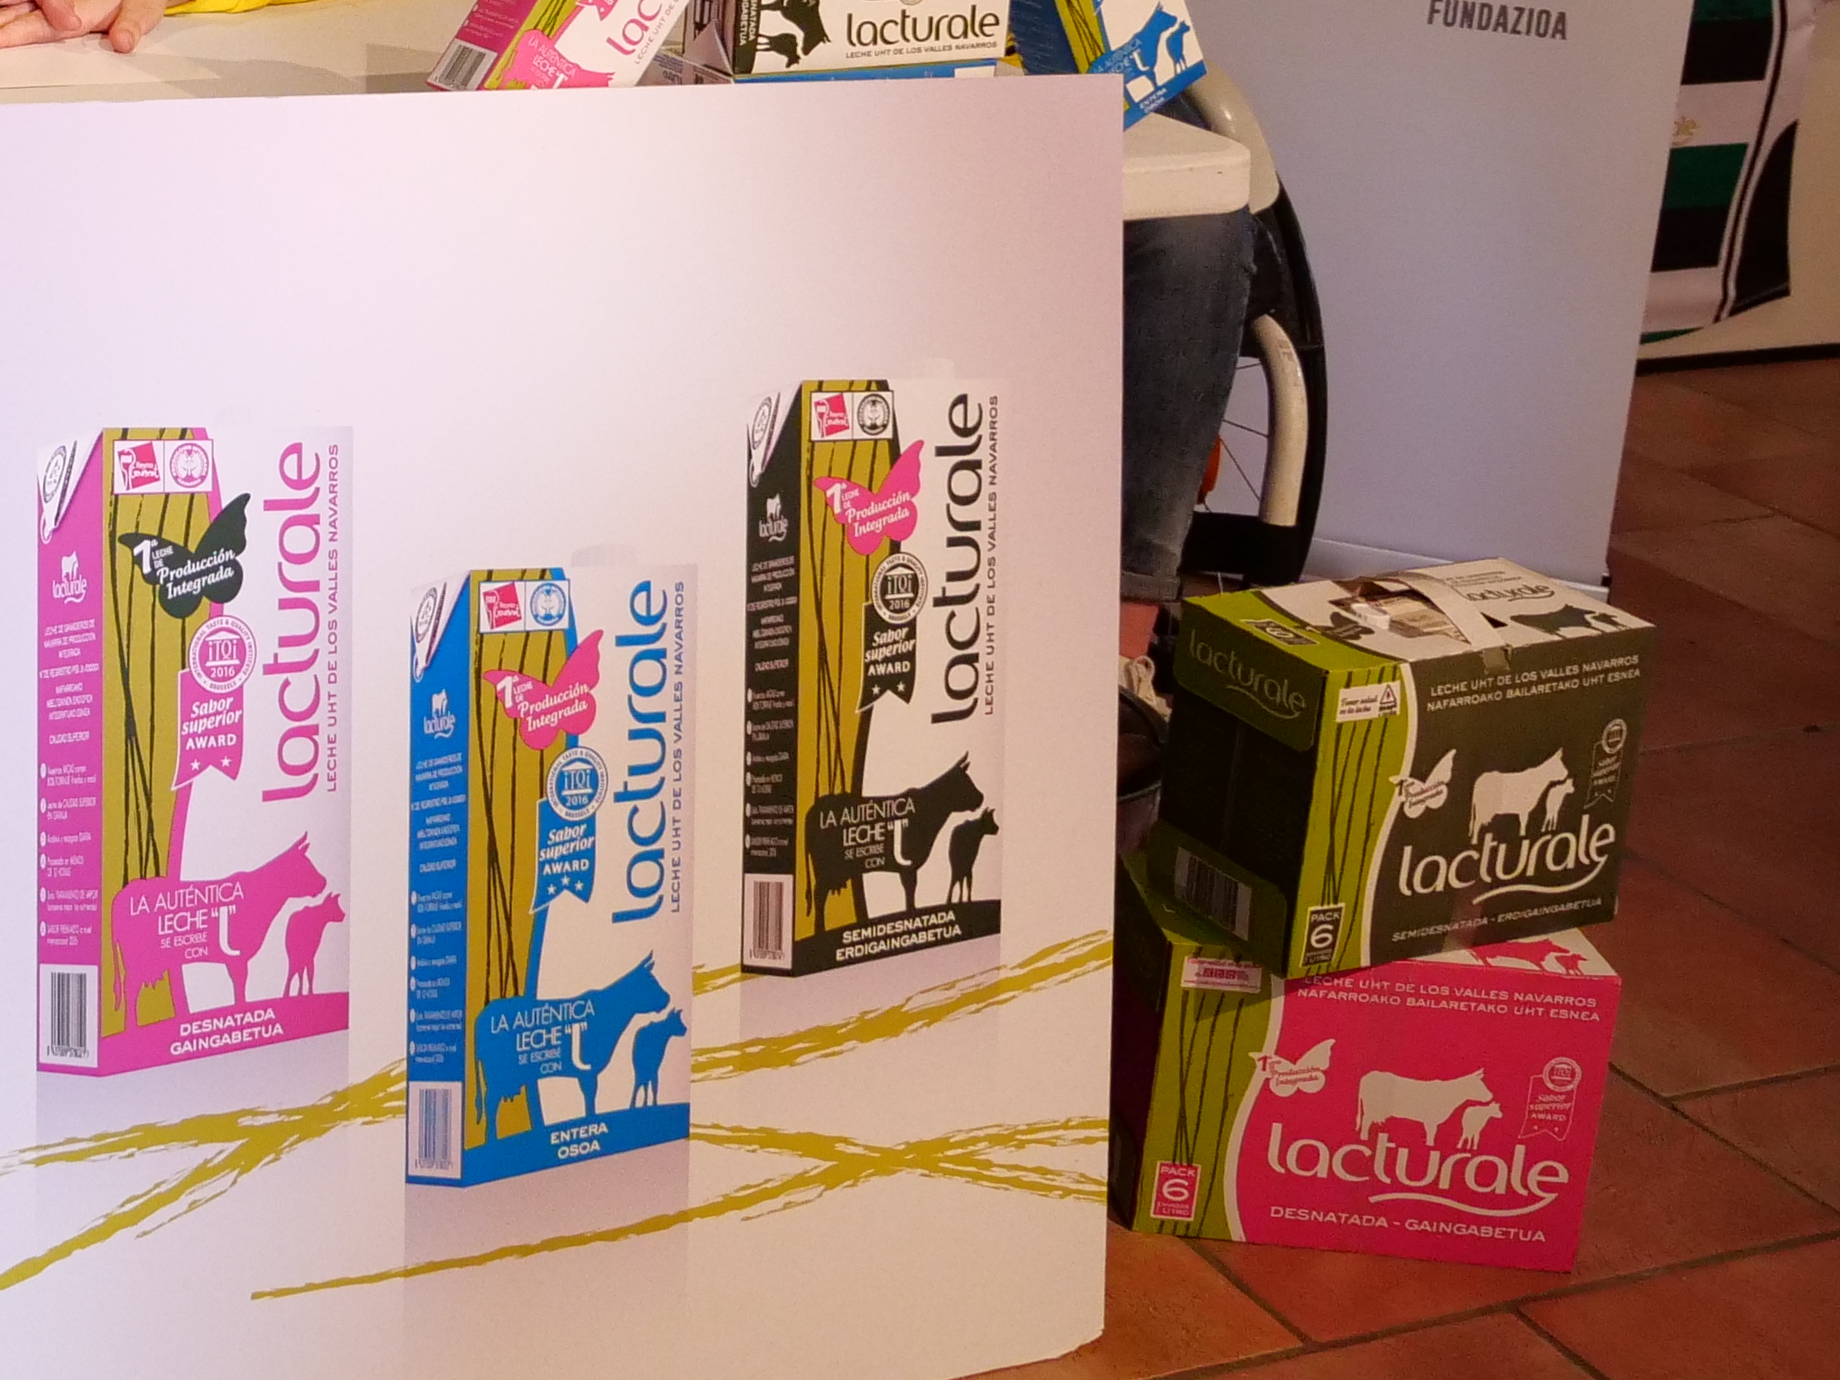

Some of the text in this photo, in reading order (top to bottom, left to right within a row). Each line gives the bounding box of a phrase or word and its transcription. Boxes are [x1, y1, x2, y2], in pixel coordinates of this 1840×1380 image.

[845, 4, 1000, 49] lacturale
[152, 546, 174, 561] LECHE
[156, 547, 237, 585] Producción
[931, 392, 984, 724] lacturale
[166, 565, 235, 600] Integrada
[262, 441, 322, 803] lacturale
[326, 443, 339, 793] LECHE UHT DE LOS VALLES NAVARROS
[207, 638, 239, 662] iTQi
[209, 666, 236, 679] 2016
[190, 696, 235, 719] Sabor
[525, 699, 589, 733] Integrada
[181, 709, 243, 737] superior
[185, 733, 237, 751] AWARD
[611, 580, 668, 924] lacturale
[543, 858, 590, 876] AWARD
[1398, 814, 1616, 905] lacturale
[129, 882, 245, 917] LA AUTÉNTICA
[158, 910, 208, 936] LECHE
[842, 910, 956, 944] SEMIDESNATADA
[1311, 911, 1340, 923] PACK
[1392, 916, 1490, 942] SEMIDESNATADA
[160, 931, 208, 950] SE ESCRIBE
[835, 924, 962, 962] ERDIGAINGABETUA
[1310, 923, 1334, 949] 6
[184, 946, 208, 960] CON
[1297, 988, 1601, 1022] NAFARROAKO BAILARETAKO UHT ESNEA
[1304, 974, 1597, 1008] LECHE UHT DE LOS VALLES NAVARROS
[180, 1007, 276, 1037] DESNATADA
[169, 1022, 284, 1056] GAINGABETUA
[550, 1122, 609, 1145] ENTERA
[557, 1140, 601, 1159] OSOA
[1161, 1166, 1196, 1177] PACK
[1267, 1122, 1569, 1217] lacturale
[1162, 1178, 1190, 1201] 6
[1270, 1206, 1547, 1243] DESNATADA GAINGABETUA
